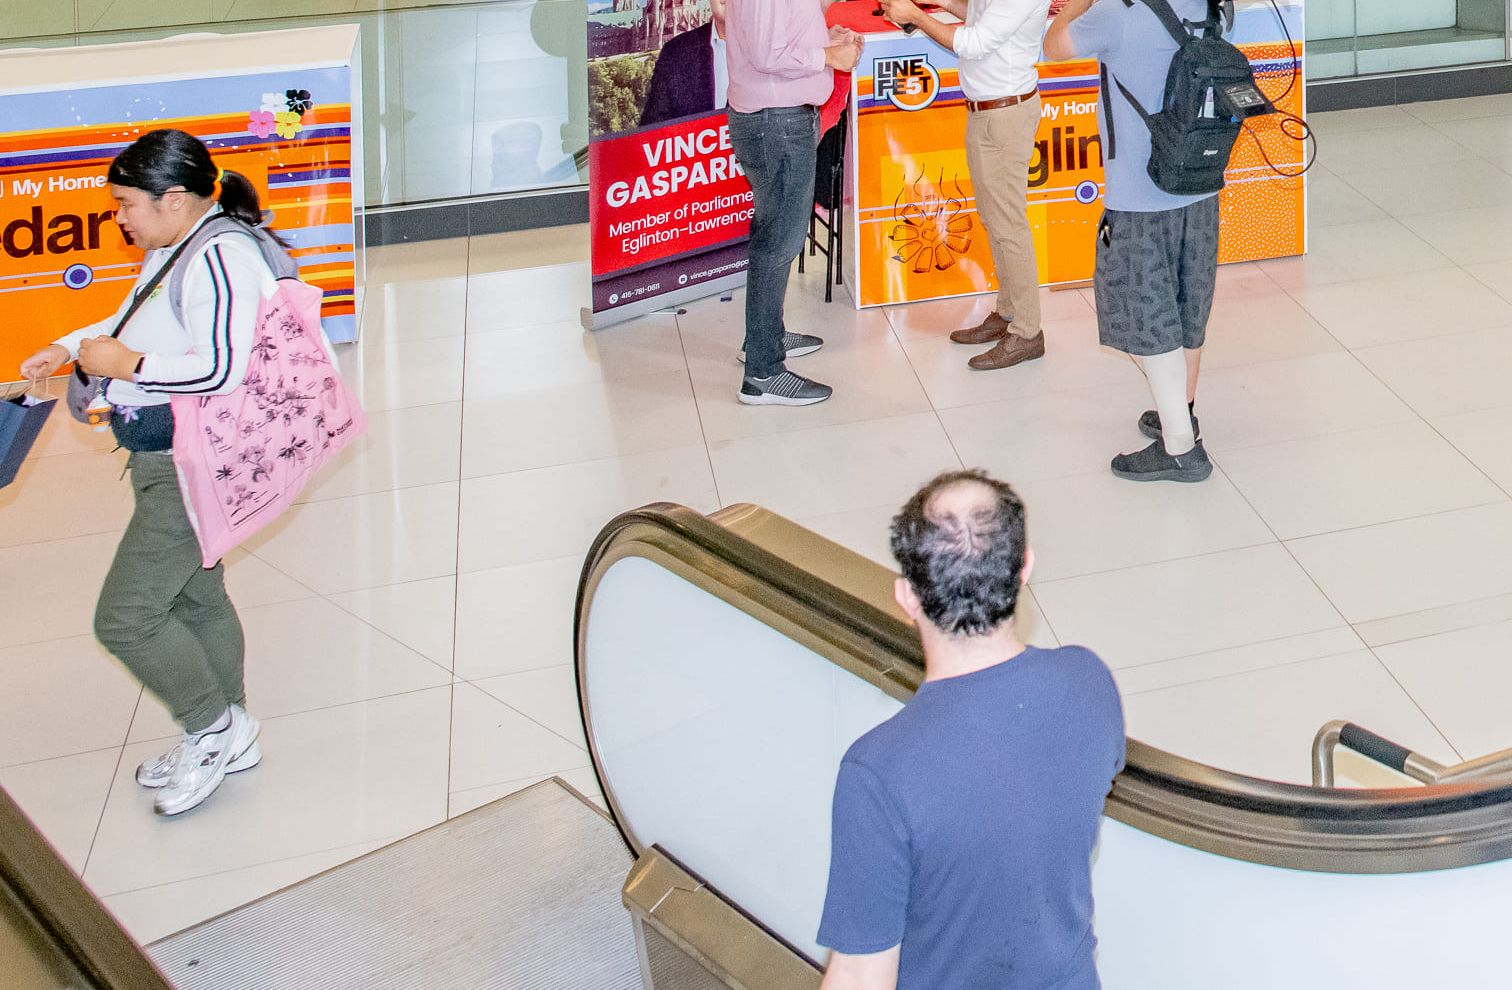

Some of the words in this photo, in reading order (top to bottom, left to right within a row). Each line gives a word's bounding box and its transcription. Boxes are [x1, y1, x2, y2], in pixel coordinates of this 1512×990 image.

[877, 59, 924, 78] LINE
[1064, 100, 1097, 116] Hom
[642, 125, 733, 167] VINCE
[12, 179, 43, 198] My
[48, 175, 107, 192] Home
[606, 153, 747, 208] GASPARR
[609, 211, 670, 238] Member
[673, 203, 689, 220] of
[691, 190, 754, 216] Parliame
